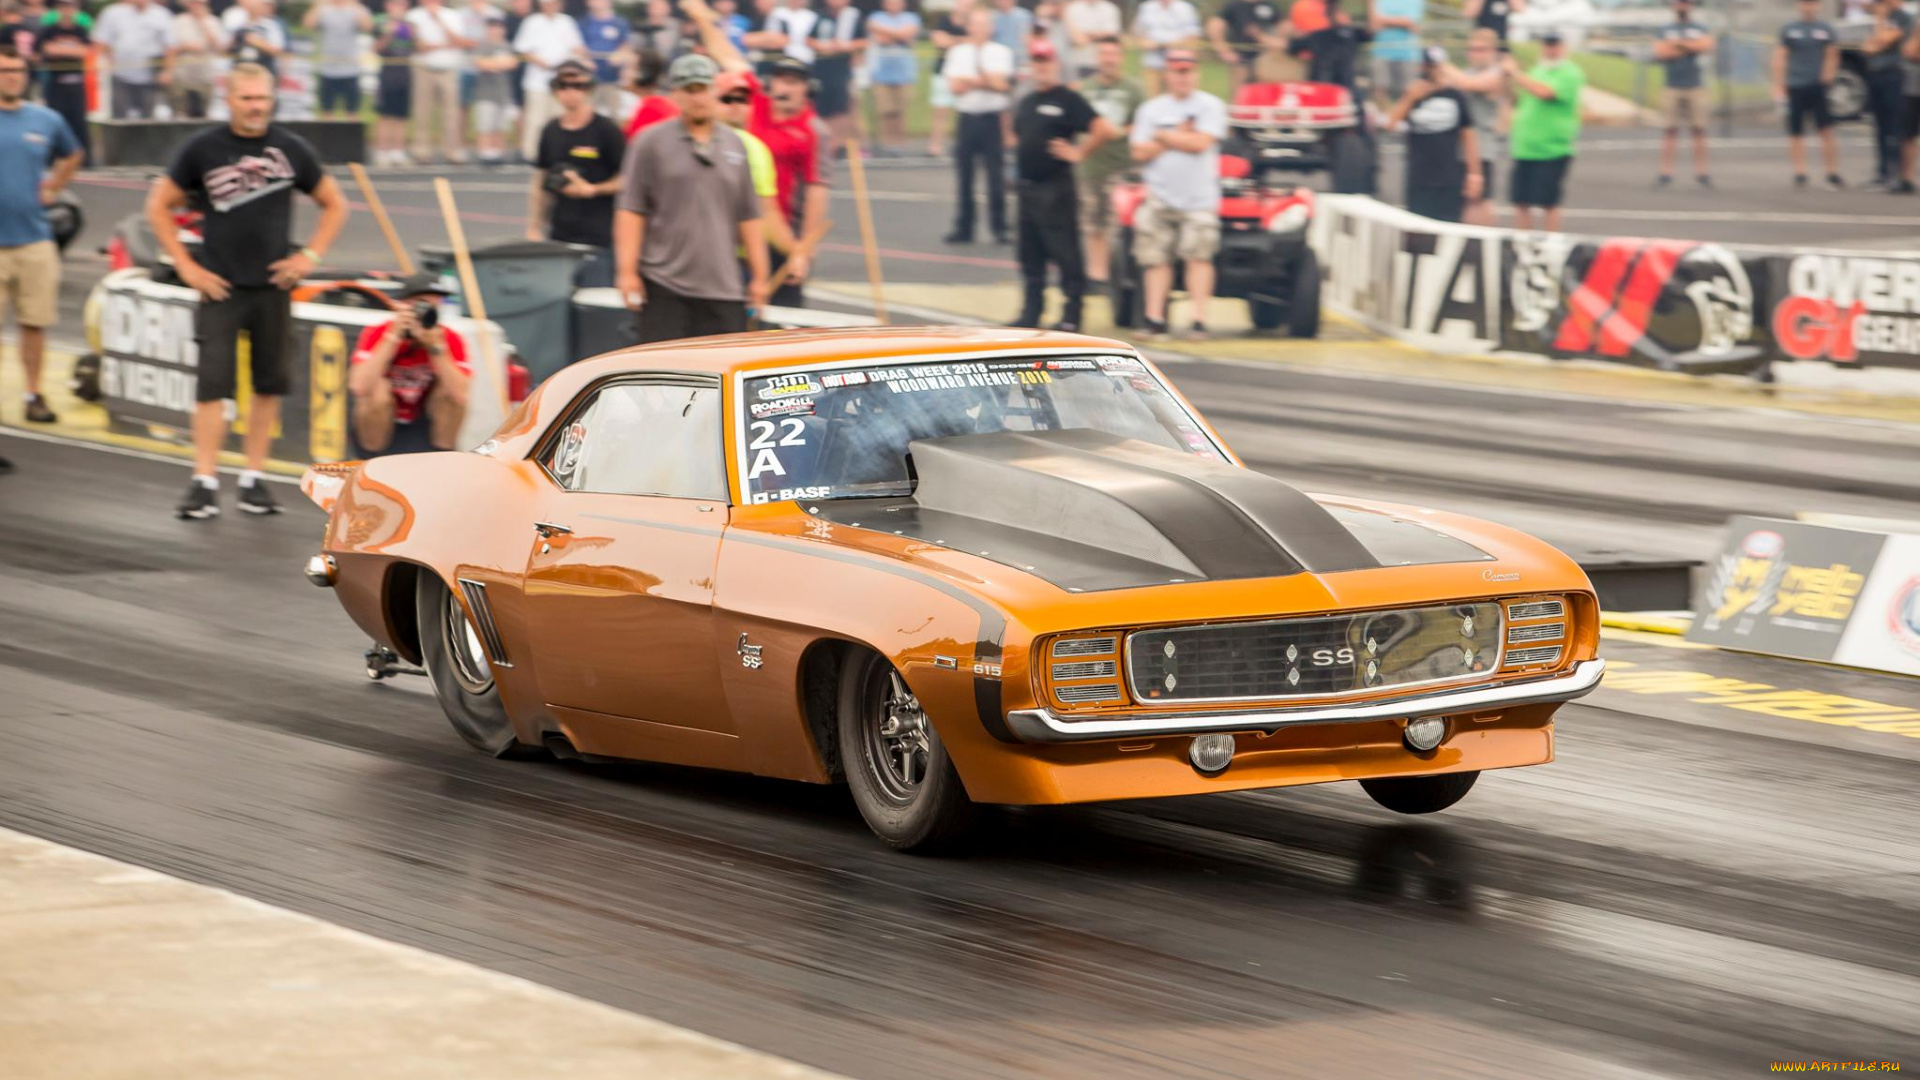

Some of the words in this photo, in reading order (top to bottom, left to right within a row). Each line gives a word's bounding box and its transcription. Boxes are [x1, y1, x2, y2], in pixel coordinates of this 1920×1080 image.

[869, 368, 908, 382] DRAG
[909, 365, 952, 378] WEEK
[952, 363, 989, 375] 2018
[886, 374, 966, 394] WOODWARD
[967, 371, 1018, 387] AVENUE
[1016, 370, 1052, 385] 2018
[751, 396, 815, 414] ROADKILL
[749, 417, 806, 450] 22
[748, 448, 787, 480] A
[780, 486, 830, 500] BASF
[742, 655, 761, 669] SS
[1312, 647, 1354, 666] SS
[973, 664, 1002, 677] 615
